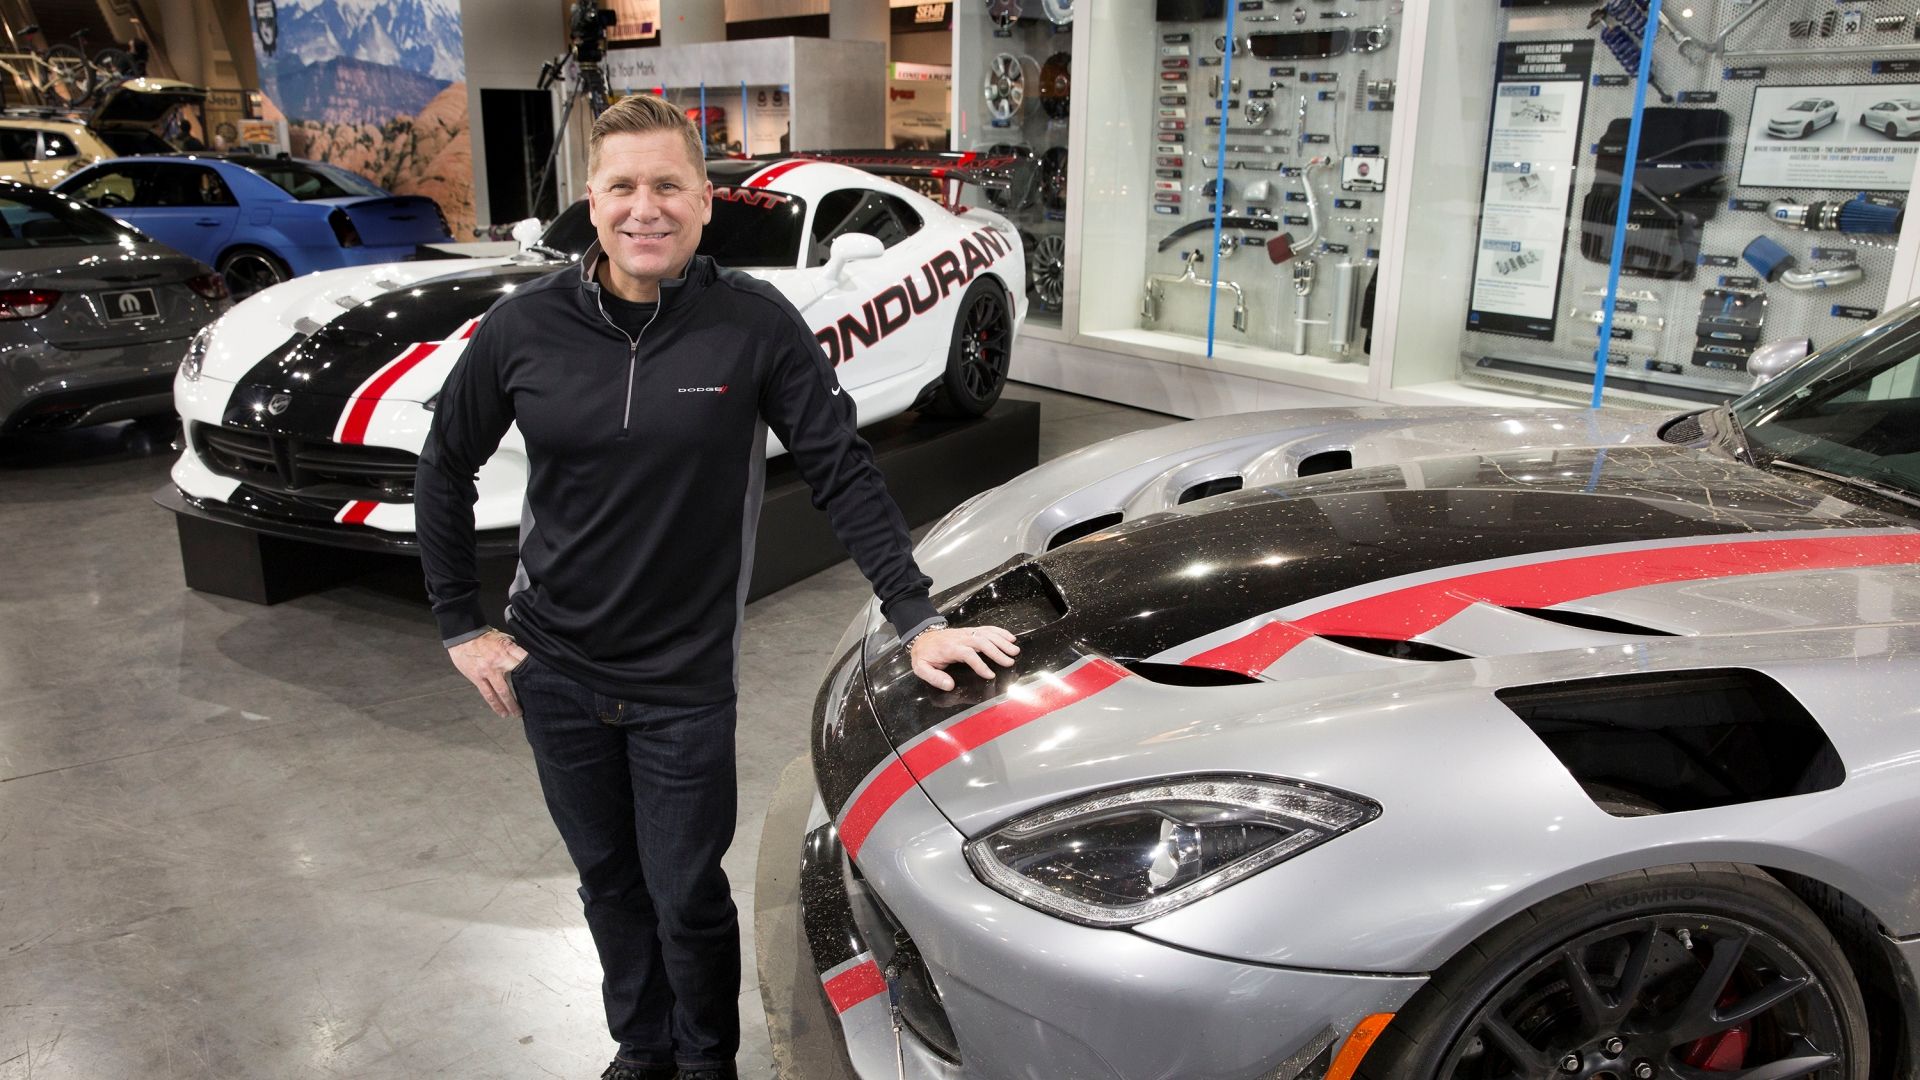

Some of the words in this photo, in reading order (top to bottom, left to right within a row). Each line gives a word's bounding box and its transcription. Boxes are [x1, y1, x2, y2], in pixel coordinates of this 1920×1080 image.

[915, 4, 946, 19] SEMA
[208, 92, 238, 106] Jeep
[1604, 887, 1698, 912] KUMHO
